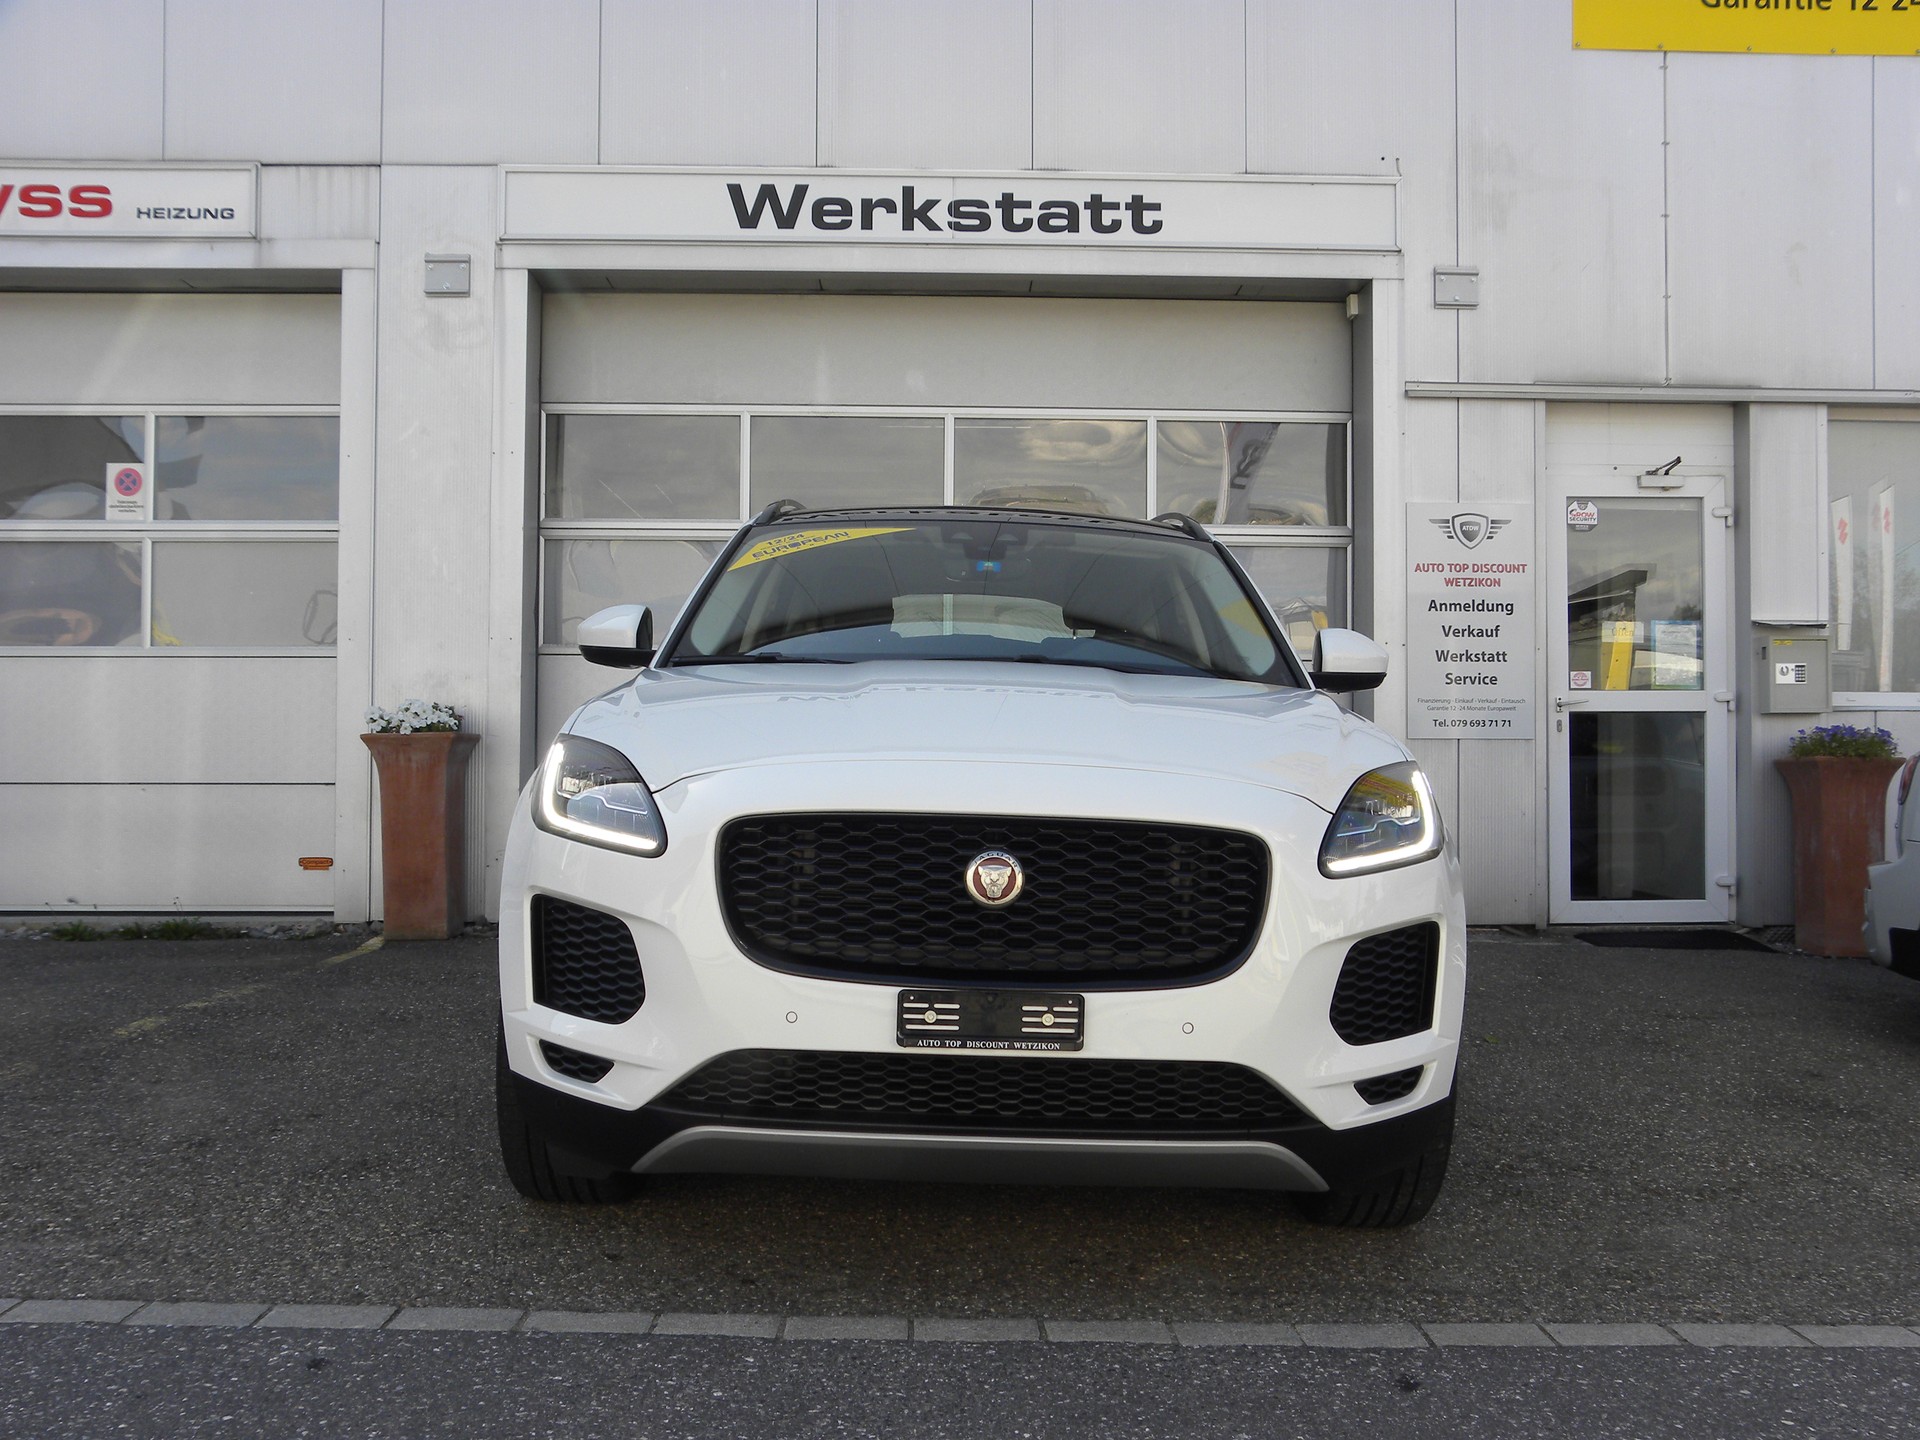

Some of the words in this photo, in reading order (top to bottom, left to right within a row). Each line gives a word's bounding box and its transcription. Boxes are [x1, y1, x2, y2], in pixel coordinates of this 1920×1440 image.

[136, 206, 236, 220] HEIZUNG
[727, 183, 1164, 235] Werkstatt
[1414, 563, 1445, 573] AUTO
[1447, 563, 1469, 573] TOP
[1472, 563, 1528, 574] DISCOUNT
[1444, 577, 1502, 588] WETZIKON
[1428, 599, 1515, 616] Anmeldung
[1441, 624, 1501, 638] Verkauf
[1435, 649, 1508, 663] Werkstatt
[1445, 672, 1498, 685] Service
[1432, 719, 1449, 728] Tel.
[1450, 719, 1468, 728] 079
[1469, 719, 1486, 728] 693
[1488, 719, 1499, 728] 71
[1501, 719, 1512, 728] 71
[966, 1041, 1010, 1049] DISCOUNT
[1013, 1042, 1061, 1050] WETZIKON
